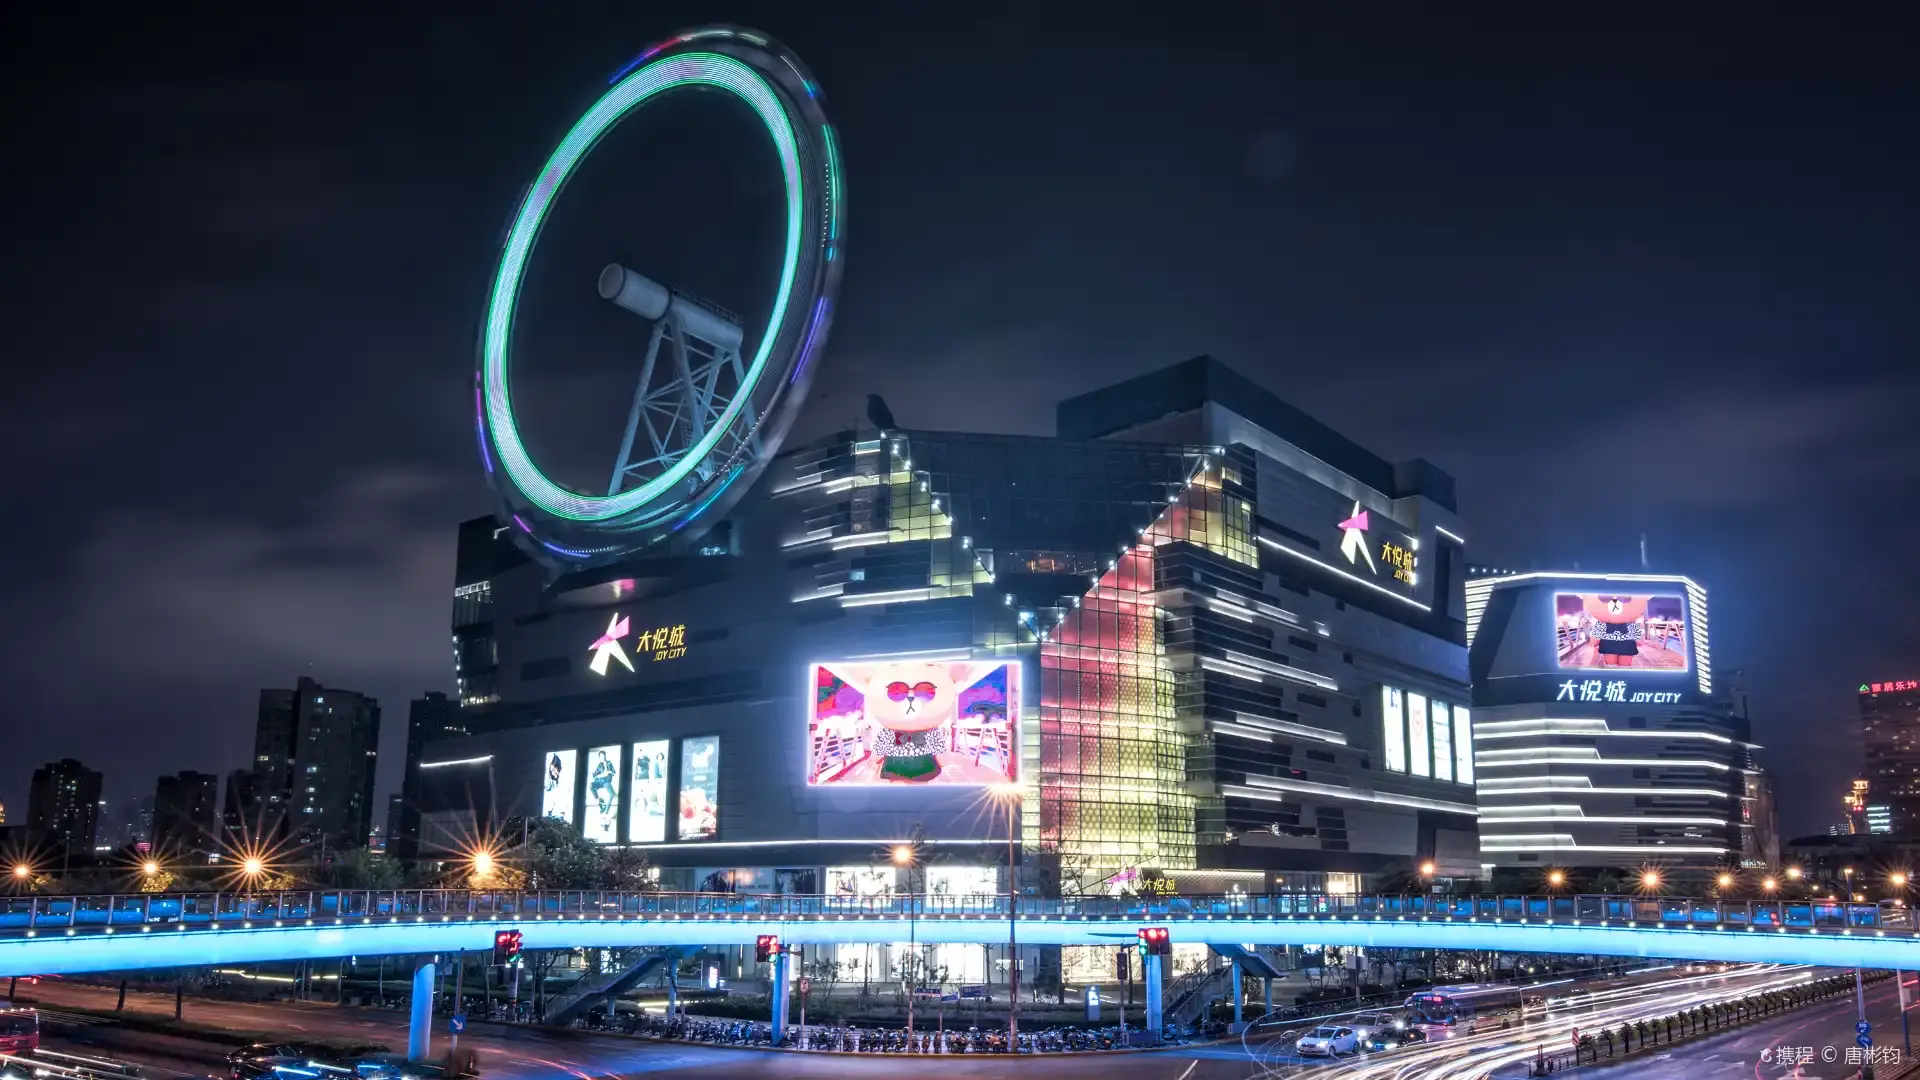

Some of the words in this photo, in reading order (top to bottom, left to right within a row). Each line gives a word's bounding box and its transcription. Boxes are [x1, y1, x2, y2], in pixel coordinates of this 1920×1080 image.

[1381, 541, 1413, 573] 大悦城
[1393, 569, 1403, 581] JOY
[636, 624, 686, 653] 大悦城
[652, 649, 668, 662] JOY
[668, 647, 688, 660] CITY
[1556, 679, 1627, 702] 大悦城
[1629, 692, 1653, 703] JOY
[1653, 692, 1682, 703] CITY
